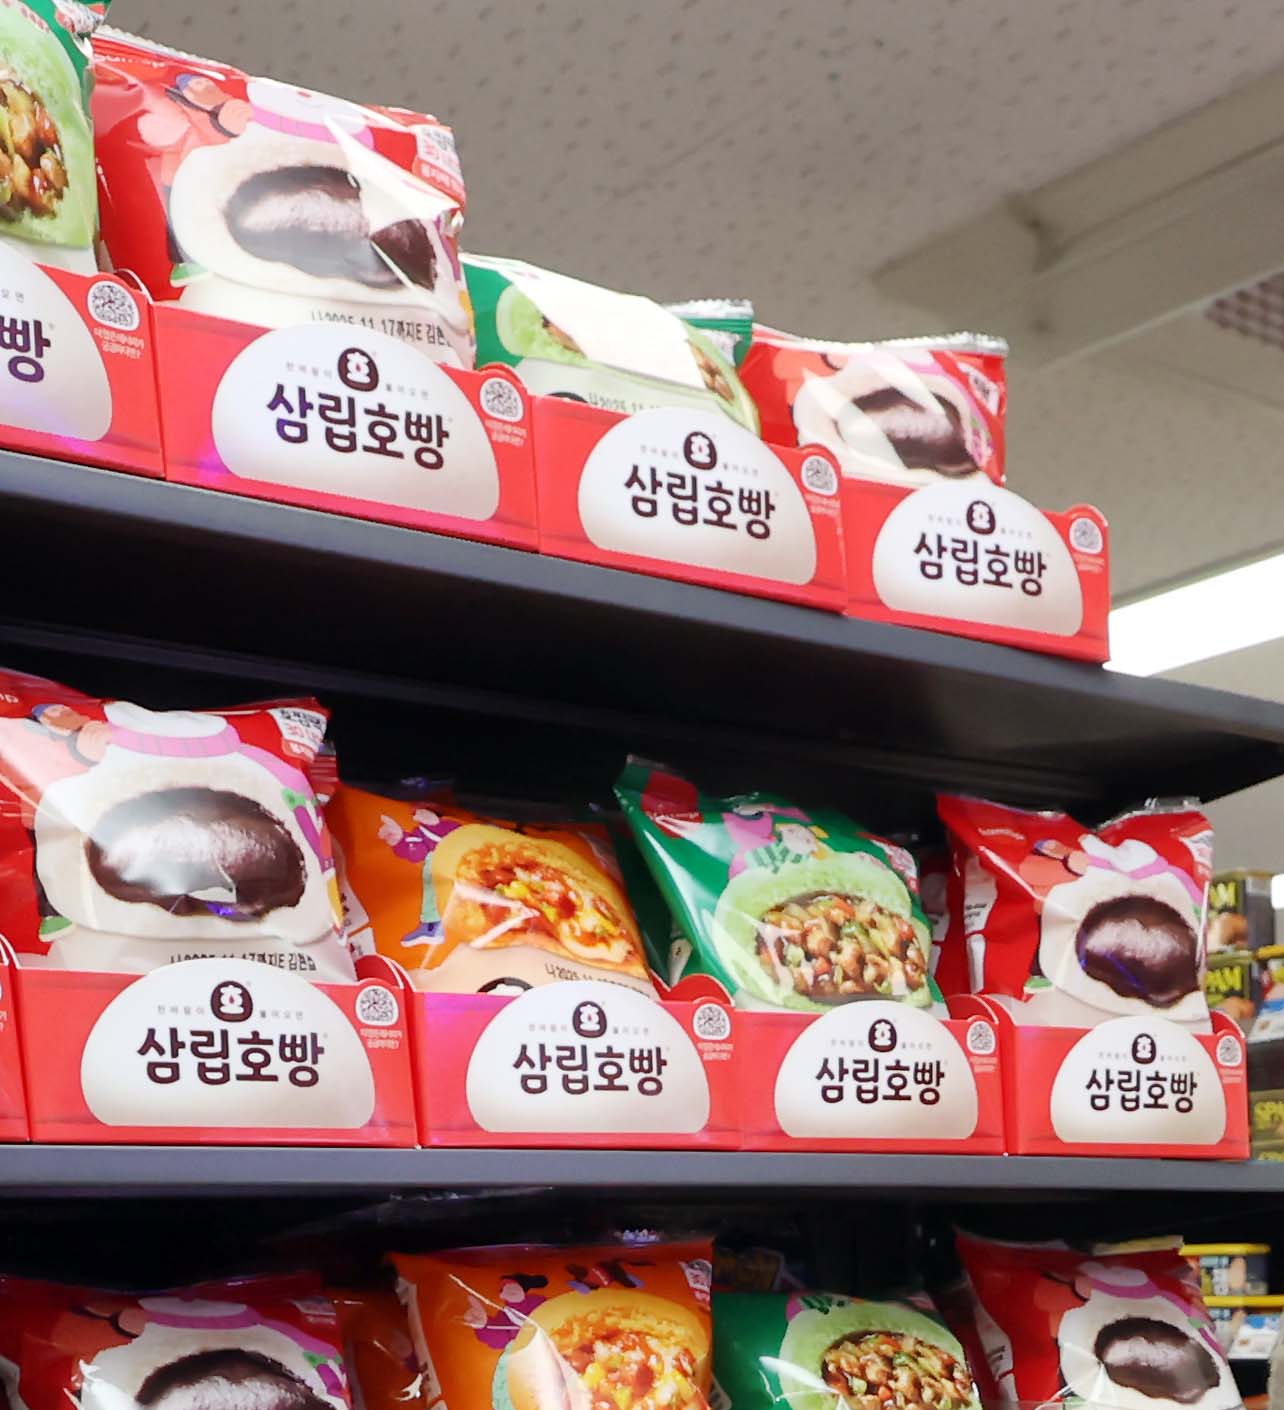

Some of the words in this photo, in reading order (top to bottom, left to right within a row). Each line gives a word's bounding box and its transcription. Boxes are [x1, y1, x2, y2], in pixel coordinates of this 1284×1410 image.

[266, 383, 450, 471] 삼립호빵
[624, 464, 775, 540] 삼립호빵
[913, 531, 1047, 597] 삼립호빵
[1205, 965, 1243, 992] PAM
[137, 1025, 326, 1088] 삼립호빵
[512, 1043, 668, 1097] 삼립호빵
[815, 1056, 946, 1106] 삼립호빵
[1085, 1067, 1199, 1114] 삼립호빵
